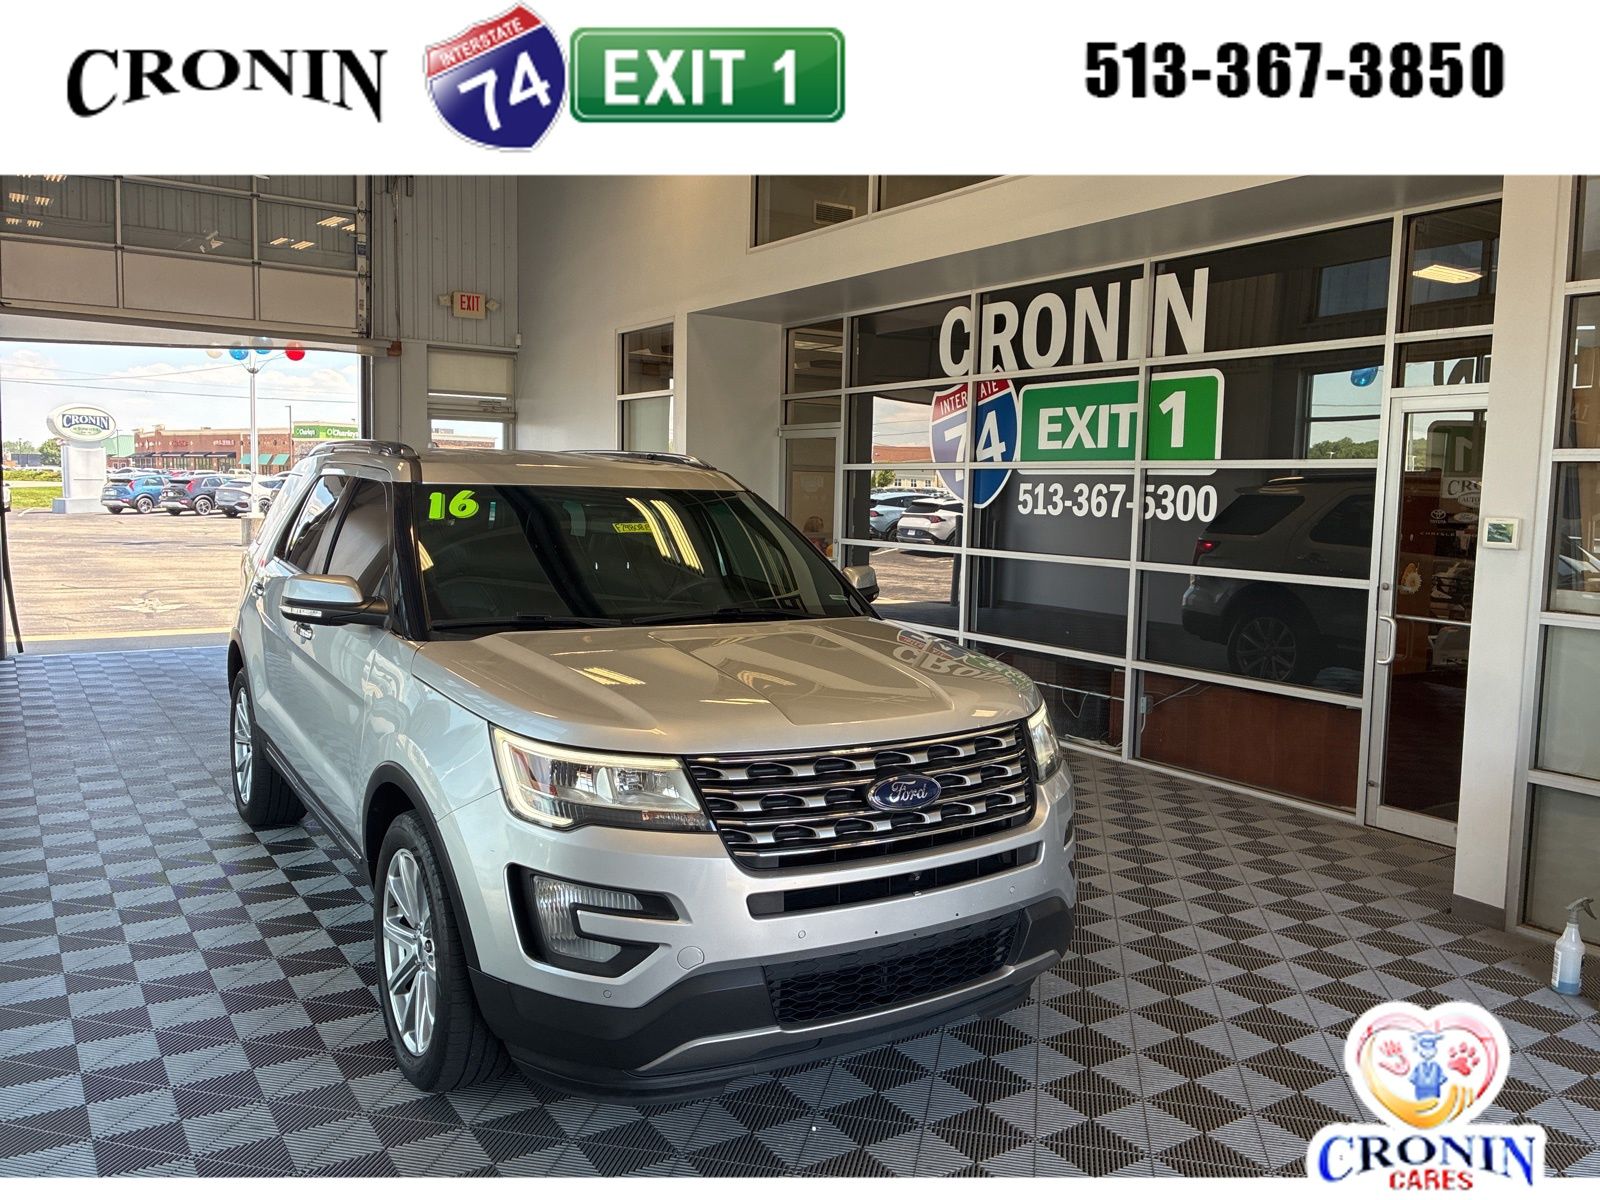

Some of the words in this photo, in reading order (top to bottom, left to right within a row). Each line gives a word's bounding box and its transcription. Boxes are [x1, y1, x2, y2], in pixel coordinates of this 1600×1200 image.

[460, 294, 480, 311] EXIT
[939, 266, 1209, 377] CRONIN
[940, 381, 999, 416] INTERATE
[63, 415, 108, 429] CRONIN
[1038, 403, 1138, 450] EXIT
[1158, 390, 1186, 448] 1
[944, 410, 1006, 482] 74
[428, 490, 480, 520] 16
[1017, 482, 1218, 522] 513-367-5300
[889, 780, 928, 803] Ford
